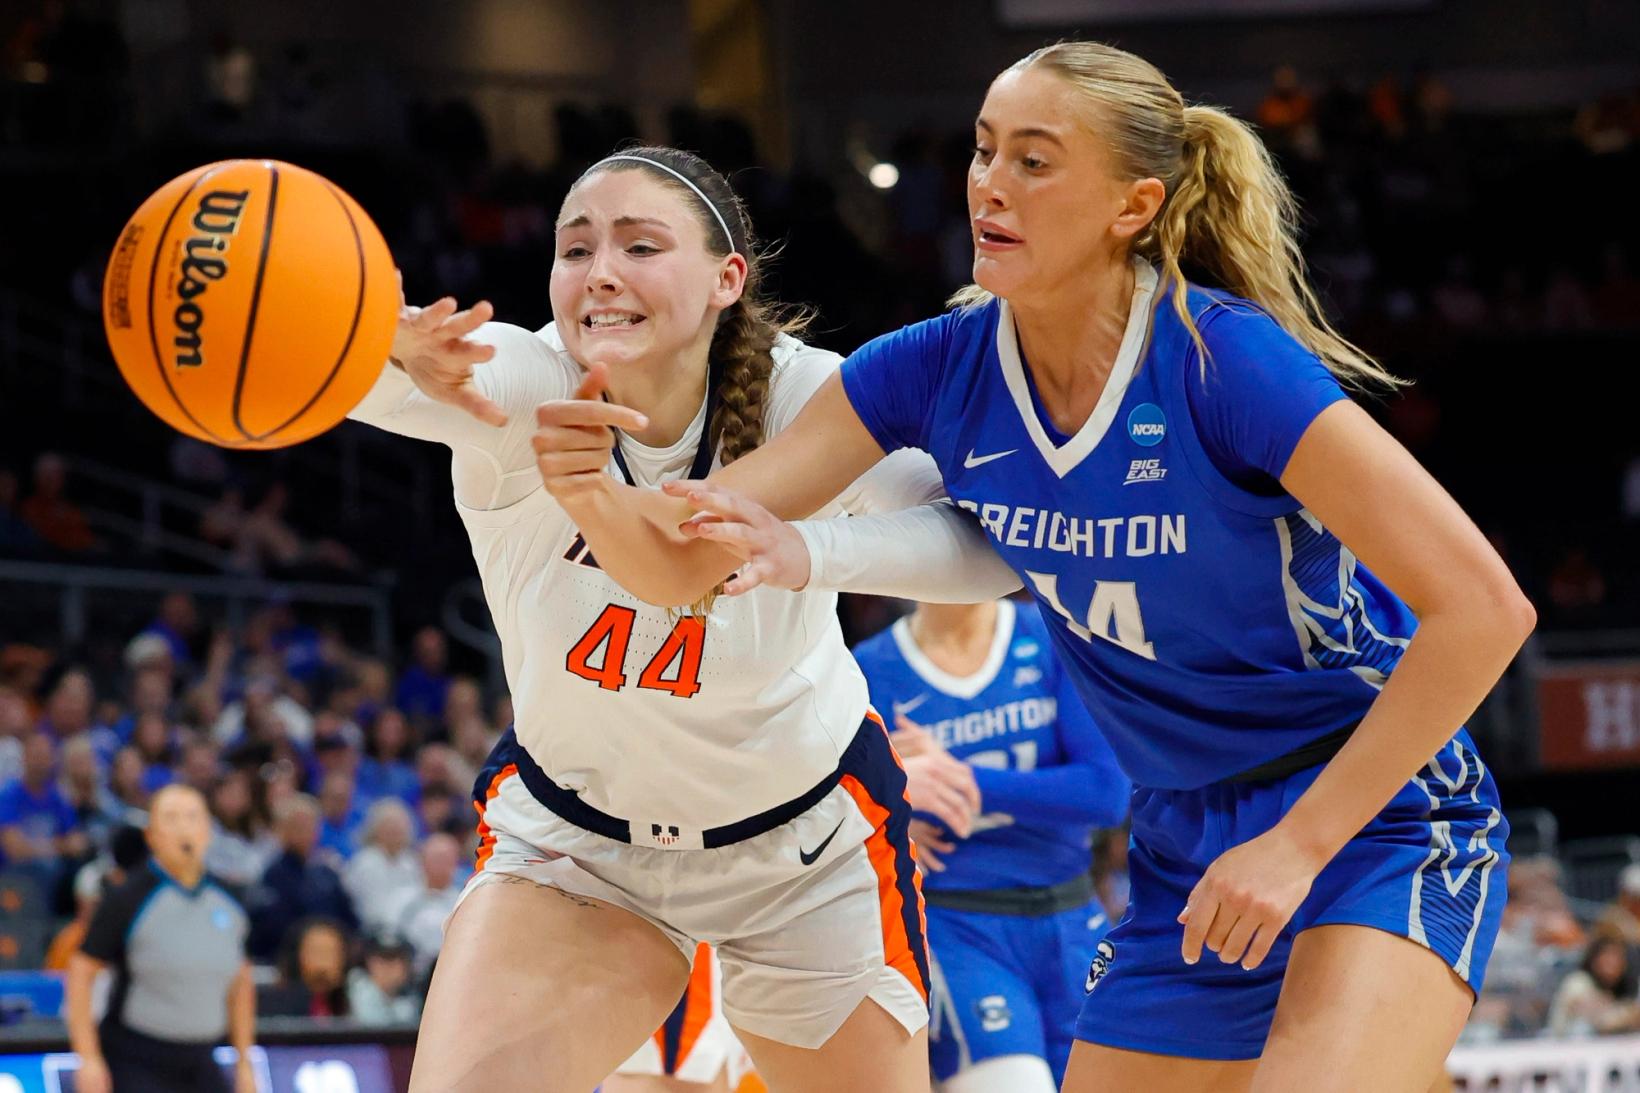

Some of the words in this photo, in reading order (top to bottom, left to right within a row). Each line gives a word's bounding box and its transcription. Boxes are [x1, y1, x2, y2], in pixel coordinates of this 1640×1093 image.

[174, 190, 248, 367] Wilson
[1132, 424, 1165, 436] NCAA
[1126, 469, 1168, 480] EAST
[1130, 459, 1160, 470] BIG
[1024, 569, 1158, 661] 14
[566, 603, 707, 699] 44
